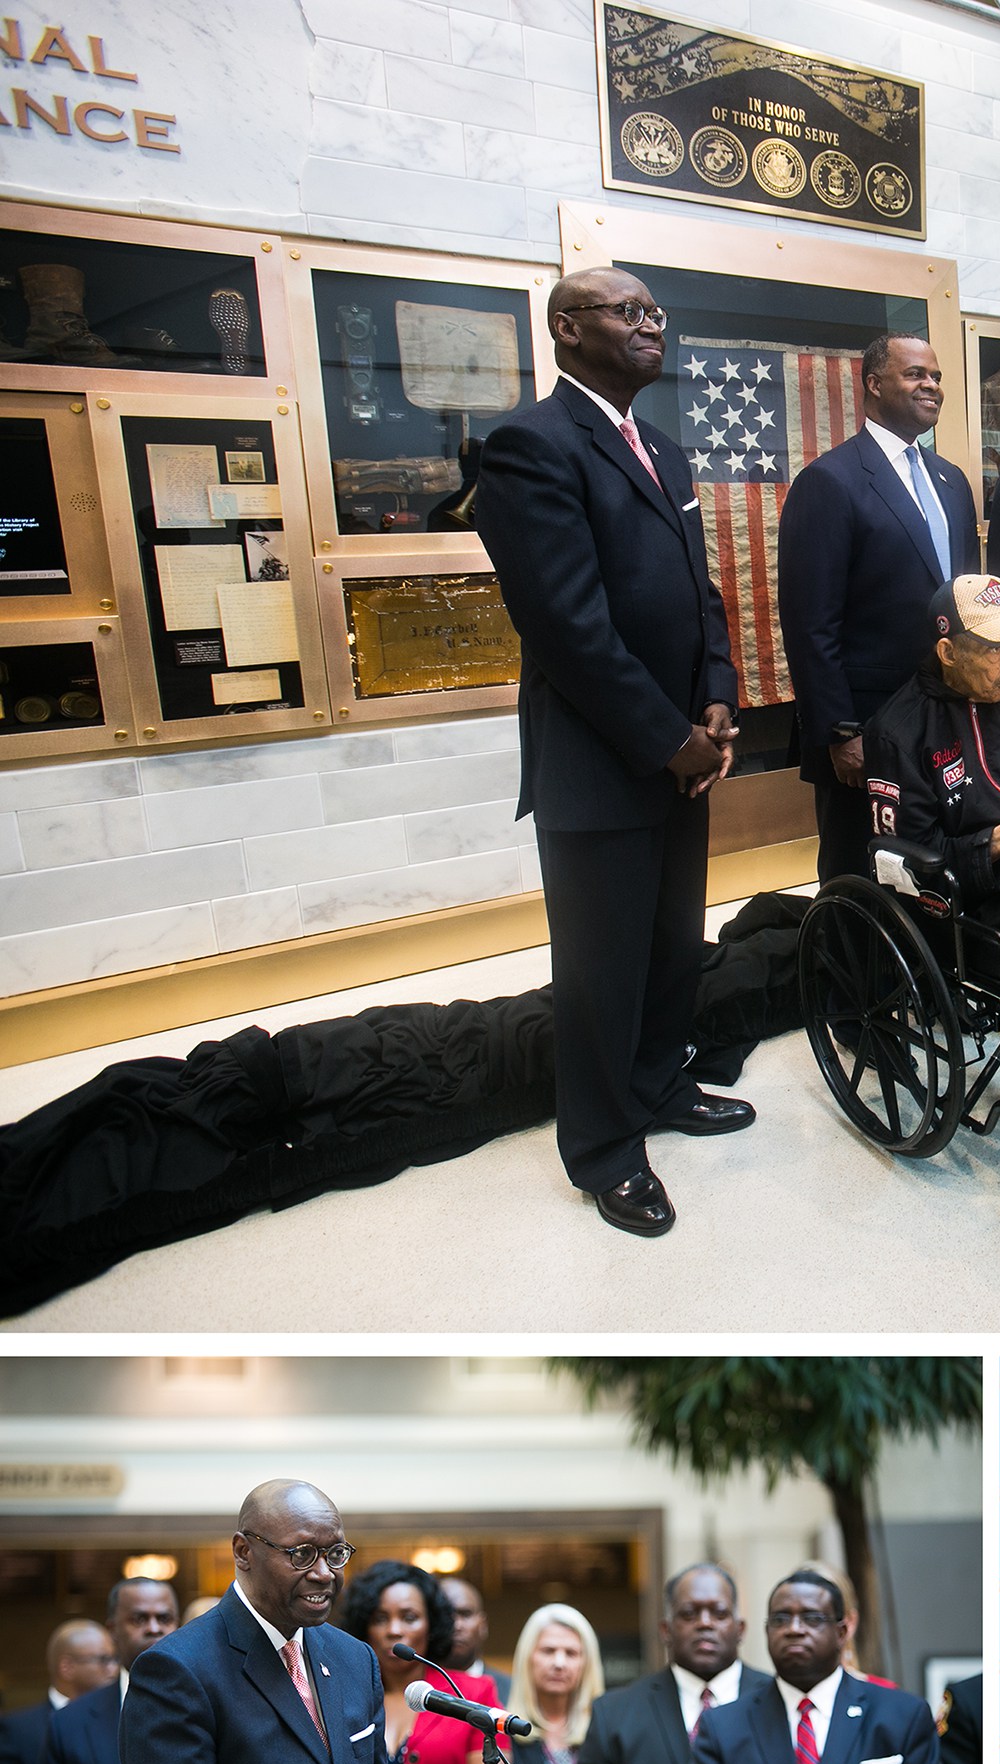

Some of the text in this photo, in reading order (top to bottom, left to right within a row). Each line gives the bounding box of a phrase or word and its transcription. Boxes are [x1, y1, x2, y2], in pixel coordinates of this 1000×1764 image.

[0, 87, 182, 155] NCE
[711, 105, 840, 147] OF THOSE WHO SERVE
[748, 96, 807, 123] IN HONOR
